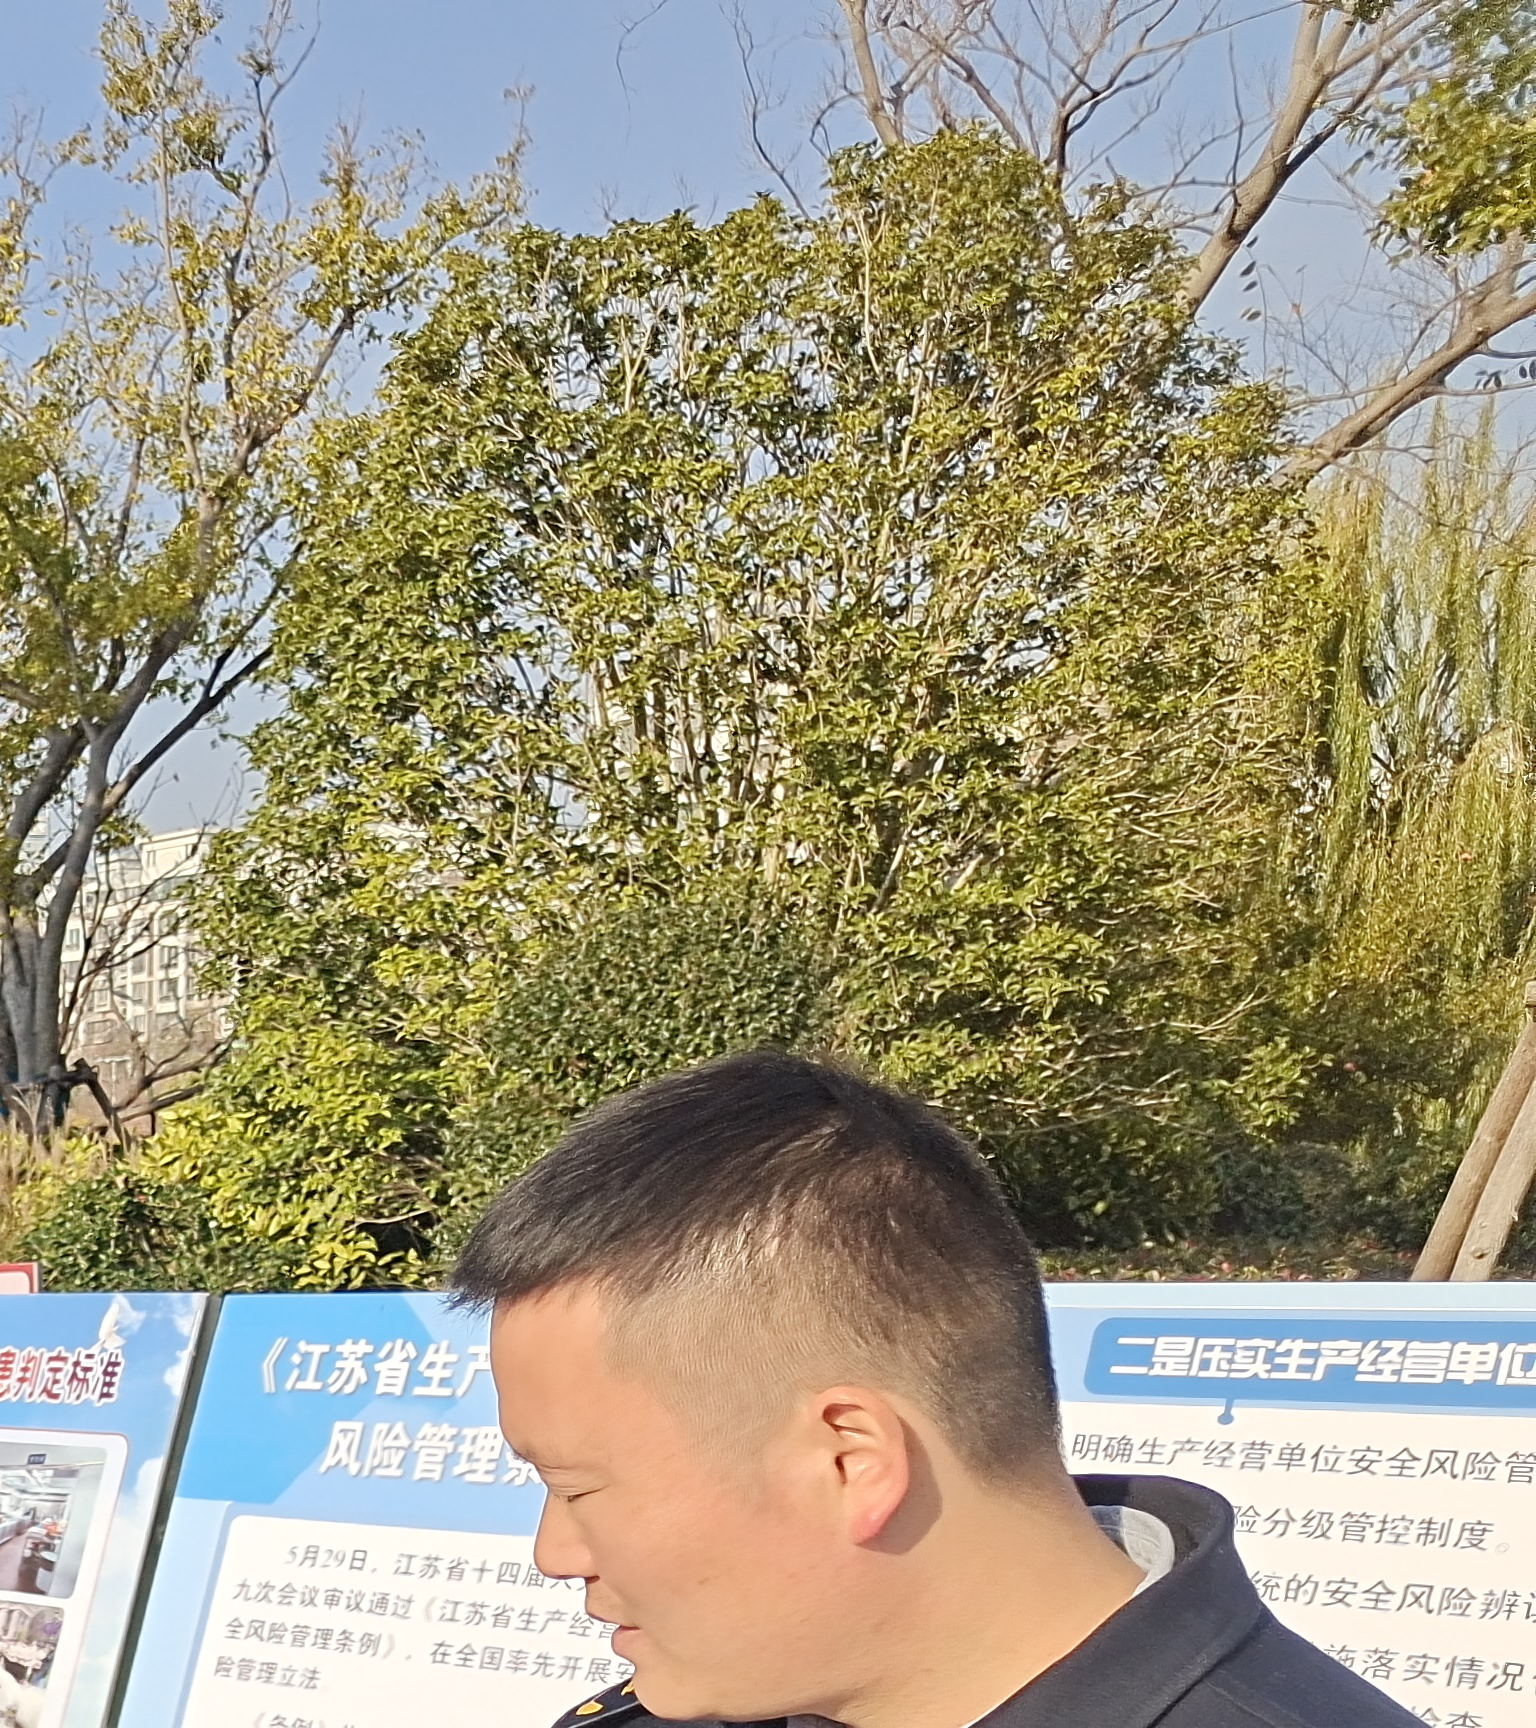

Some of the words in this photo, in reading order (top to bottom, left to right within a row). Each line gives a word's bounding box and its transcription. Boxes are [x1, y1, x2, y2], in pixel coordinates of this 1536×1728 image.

[1110, 1336, 1536, 1387] 二是压实生产经营单位
[1072, 1433, 1536, 1486] 明确生产经营单位安全风险管
[286, 1545, 585, 1592] 5月29日，江苏省十四届
